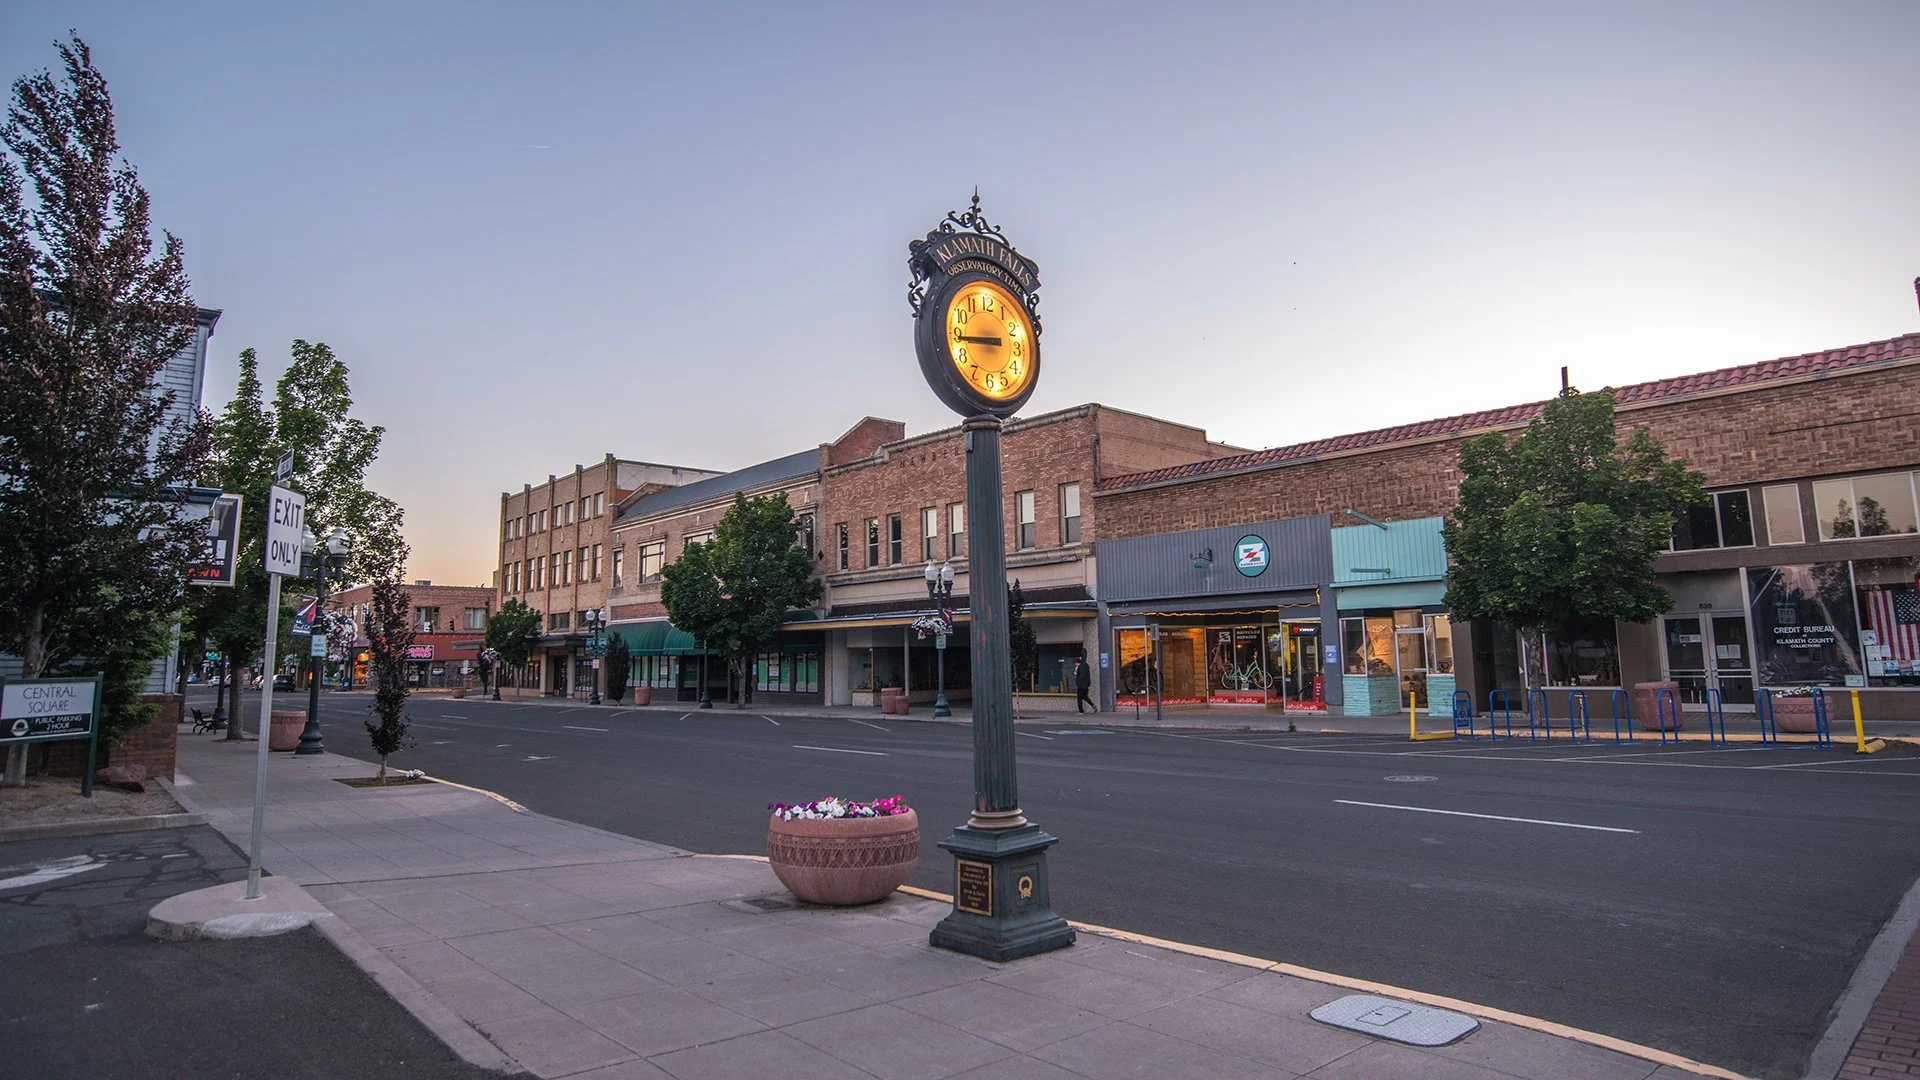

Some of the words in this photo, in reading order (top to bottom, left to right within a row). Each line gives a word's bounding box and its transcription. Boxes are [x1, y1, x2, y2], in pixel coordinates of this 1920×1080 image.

[936, 237, 994, 263] KLAMATH
[999, 248, 1032, 286] FALLS
[947, 260, 1003, 280] OBSERVATORY
[967, 297, 976, 313] 11
[982, 296, 994, 313] 12
[957, 309, 968, 324] 10
[1000, 306, 1005, 320] 1
[1009, 322, 1017, 337] 2
[958, 348, 968, 364] 8
[1013, 342, 1021, 356] 3
[970, 365, 979, 381] 7
[1009, 360, 1019, 374] 4
[985, 373, 995, 389] 6
[1000, 371, 1009, 387] 5
[274, 498, 301, 529] EXIT
[271, 540, 299, 567] ONLY
[1773, 626, 1801, 634] CREDIT
[1803, 625, 1835, 633] BUREAU
[23, 686, 76, 699] CENTRAL
[28, 700, 69, 713] SQUARE
[57, 714, 82, 722] PARKING
